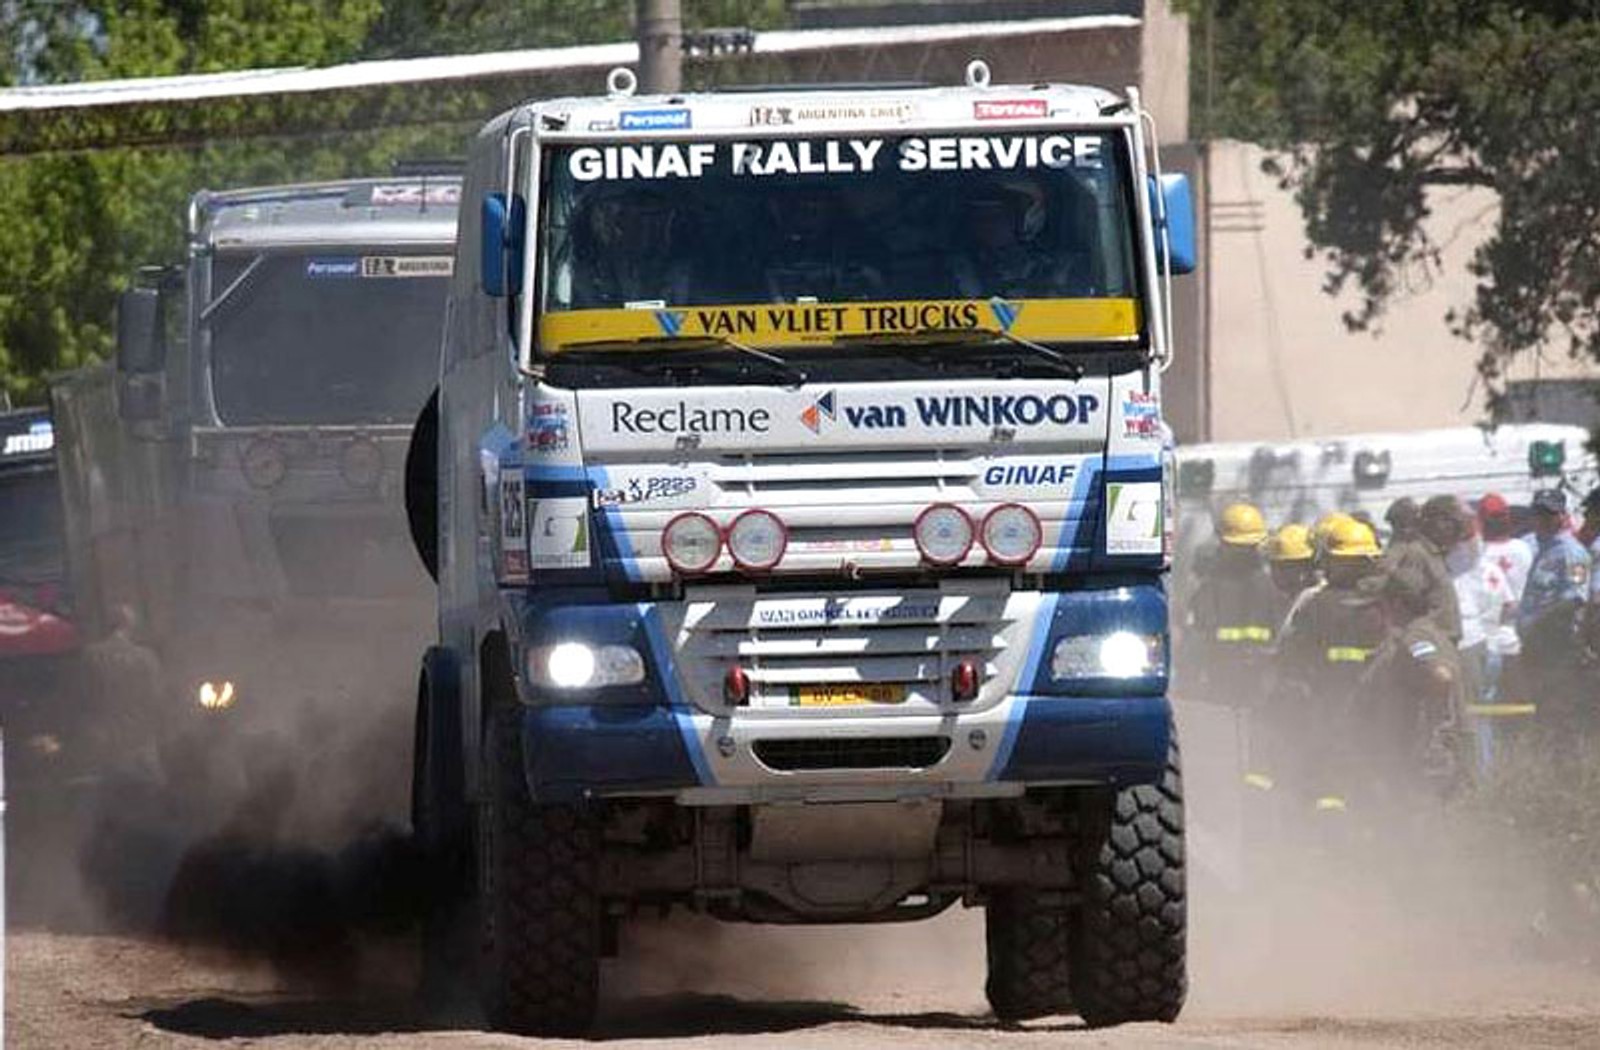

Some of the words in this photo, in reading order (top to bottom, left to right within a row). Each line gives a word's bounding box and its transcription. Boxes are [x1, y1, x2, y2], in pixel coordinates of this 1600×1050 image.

[569, 143, 717, 181] GINAF
[733, 140, 883, 176] RALLY
[899, 136, 1103, 171] SERVICE
[698, 311, 756, 333] VAN
[768, 307, 848, 331] VLIET
[858, 303, 979, 330] TRUCKS
[611, 401, 770, 433] Reclame
[846, 404, 906, 428] van
[915, 394, 1099, 425] WINKOOP
[984, 465, 1077, 486] GINAF
